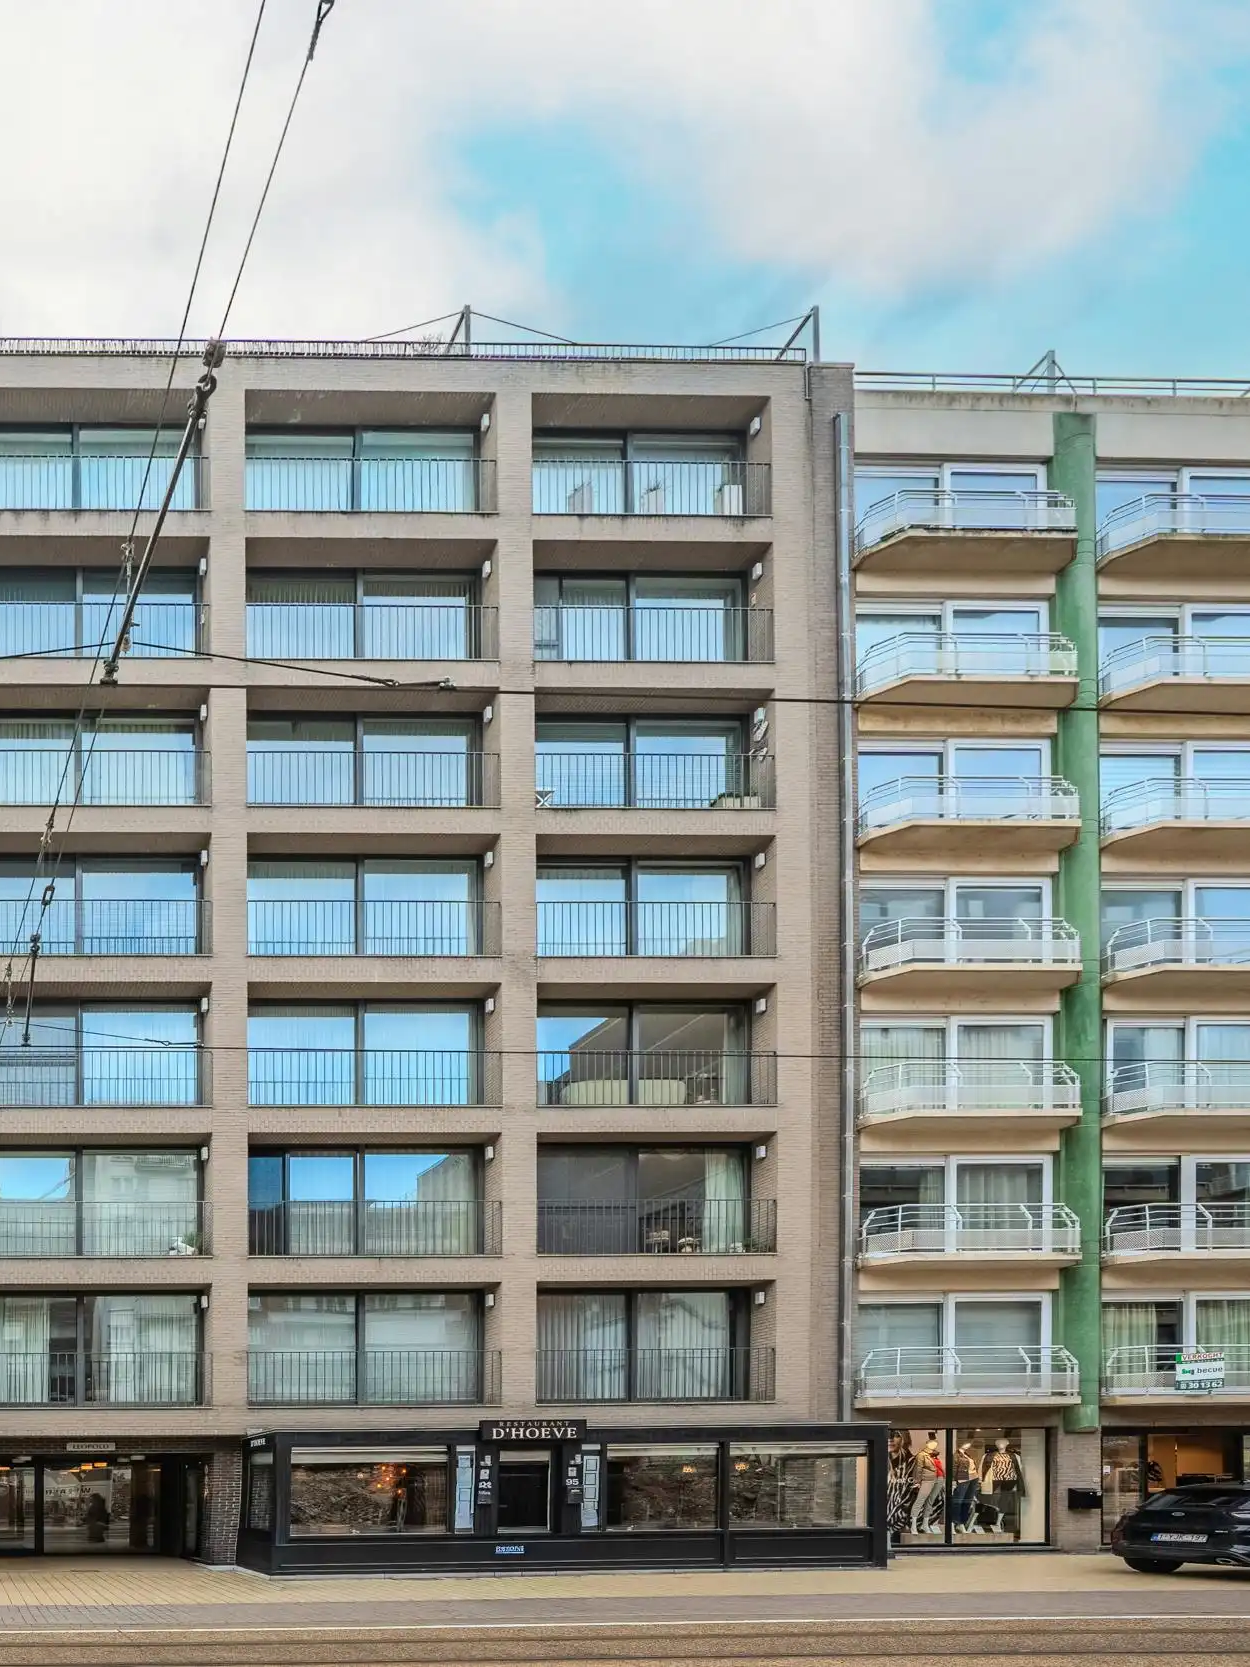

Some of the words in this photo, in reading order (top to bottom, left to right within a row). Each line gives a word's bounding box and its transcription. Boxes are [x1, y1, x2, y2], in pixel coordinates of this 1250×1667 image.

[1182, 1352, 1223, 1361] VERKOCHT
[492, 1427, 577, 1439] D'HOEVE
[565, 1478, 579, 1486] 95
